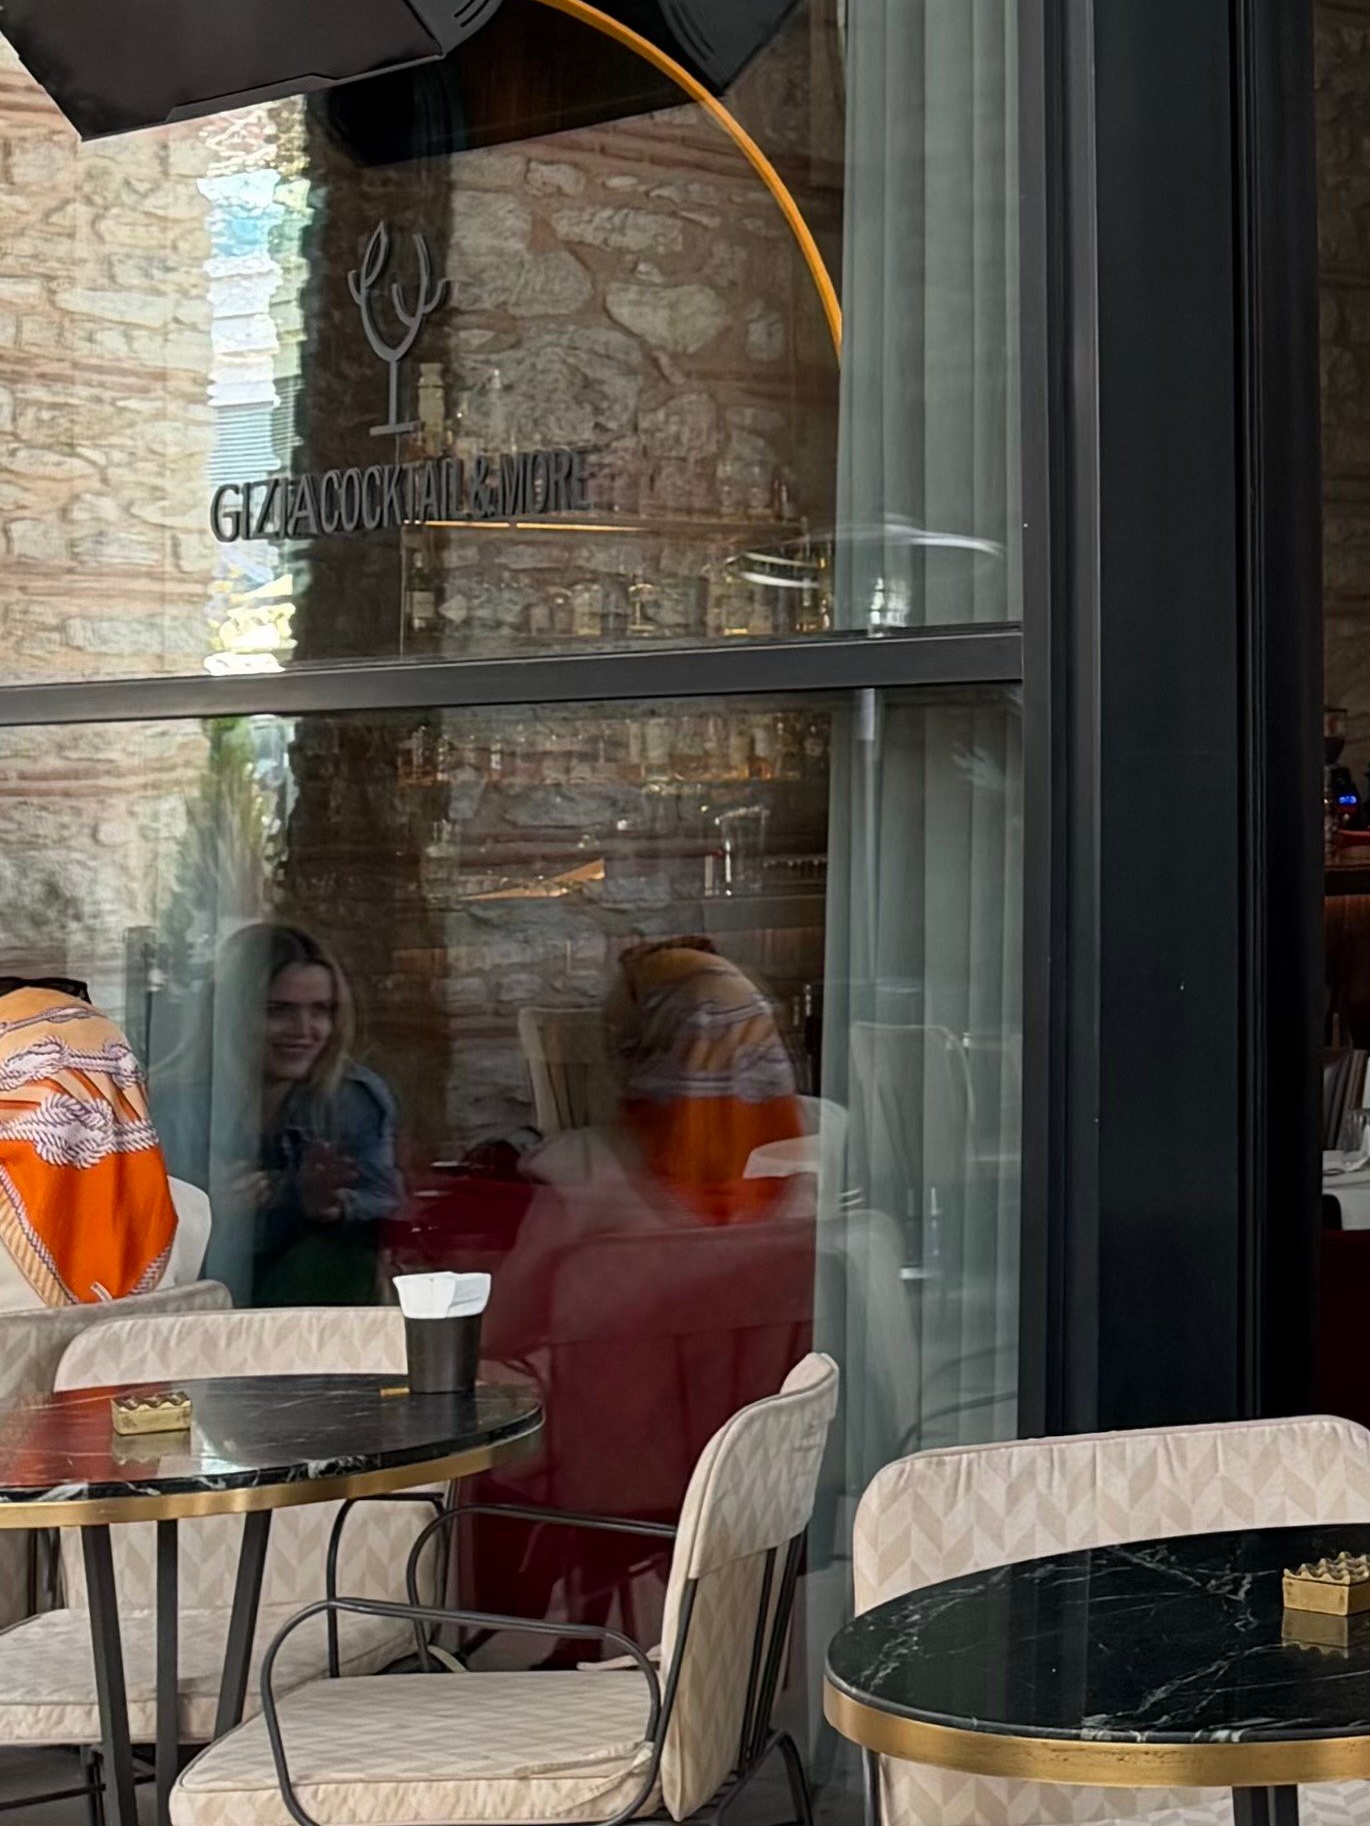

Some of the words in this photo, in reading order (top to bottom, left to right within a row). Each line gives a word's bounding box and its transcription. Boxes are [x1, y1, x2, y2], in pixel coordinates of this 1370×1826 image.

[211, 475, 325, 543] GIZIA
[320, 456, 466, 533] COCKTAIL
[470, 454, 497, 518] &
[500, 447, 593, 516] MORE
